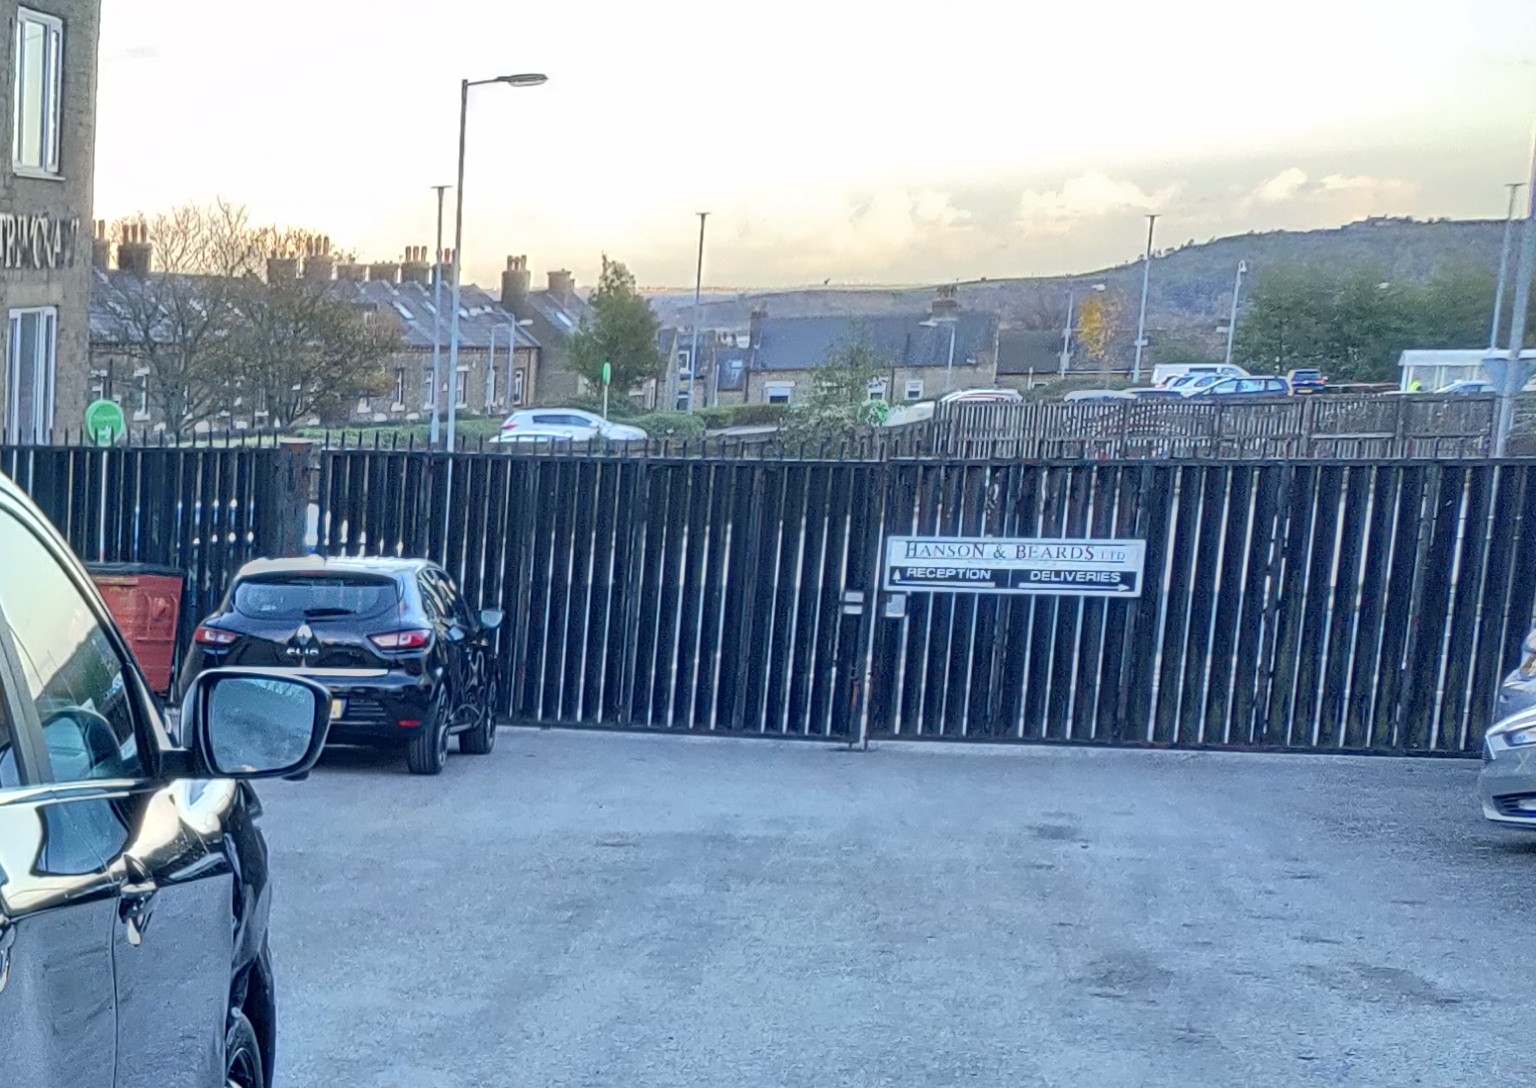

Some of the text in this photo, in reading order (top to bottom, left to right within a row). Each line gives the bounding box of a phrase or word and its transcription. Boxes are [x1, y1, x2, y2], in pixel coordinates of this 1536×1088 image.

[905, 541, 1126, 561] HANSON & BEARDS LTD
[906, 567, 992, 580] RECEPTION
[1030, 570, 1121, 583] DELIVERIES
